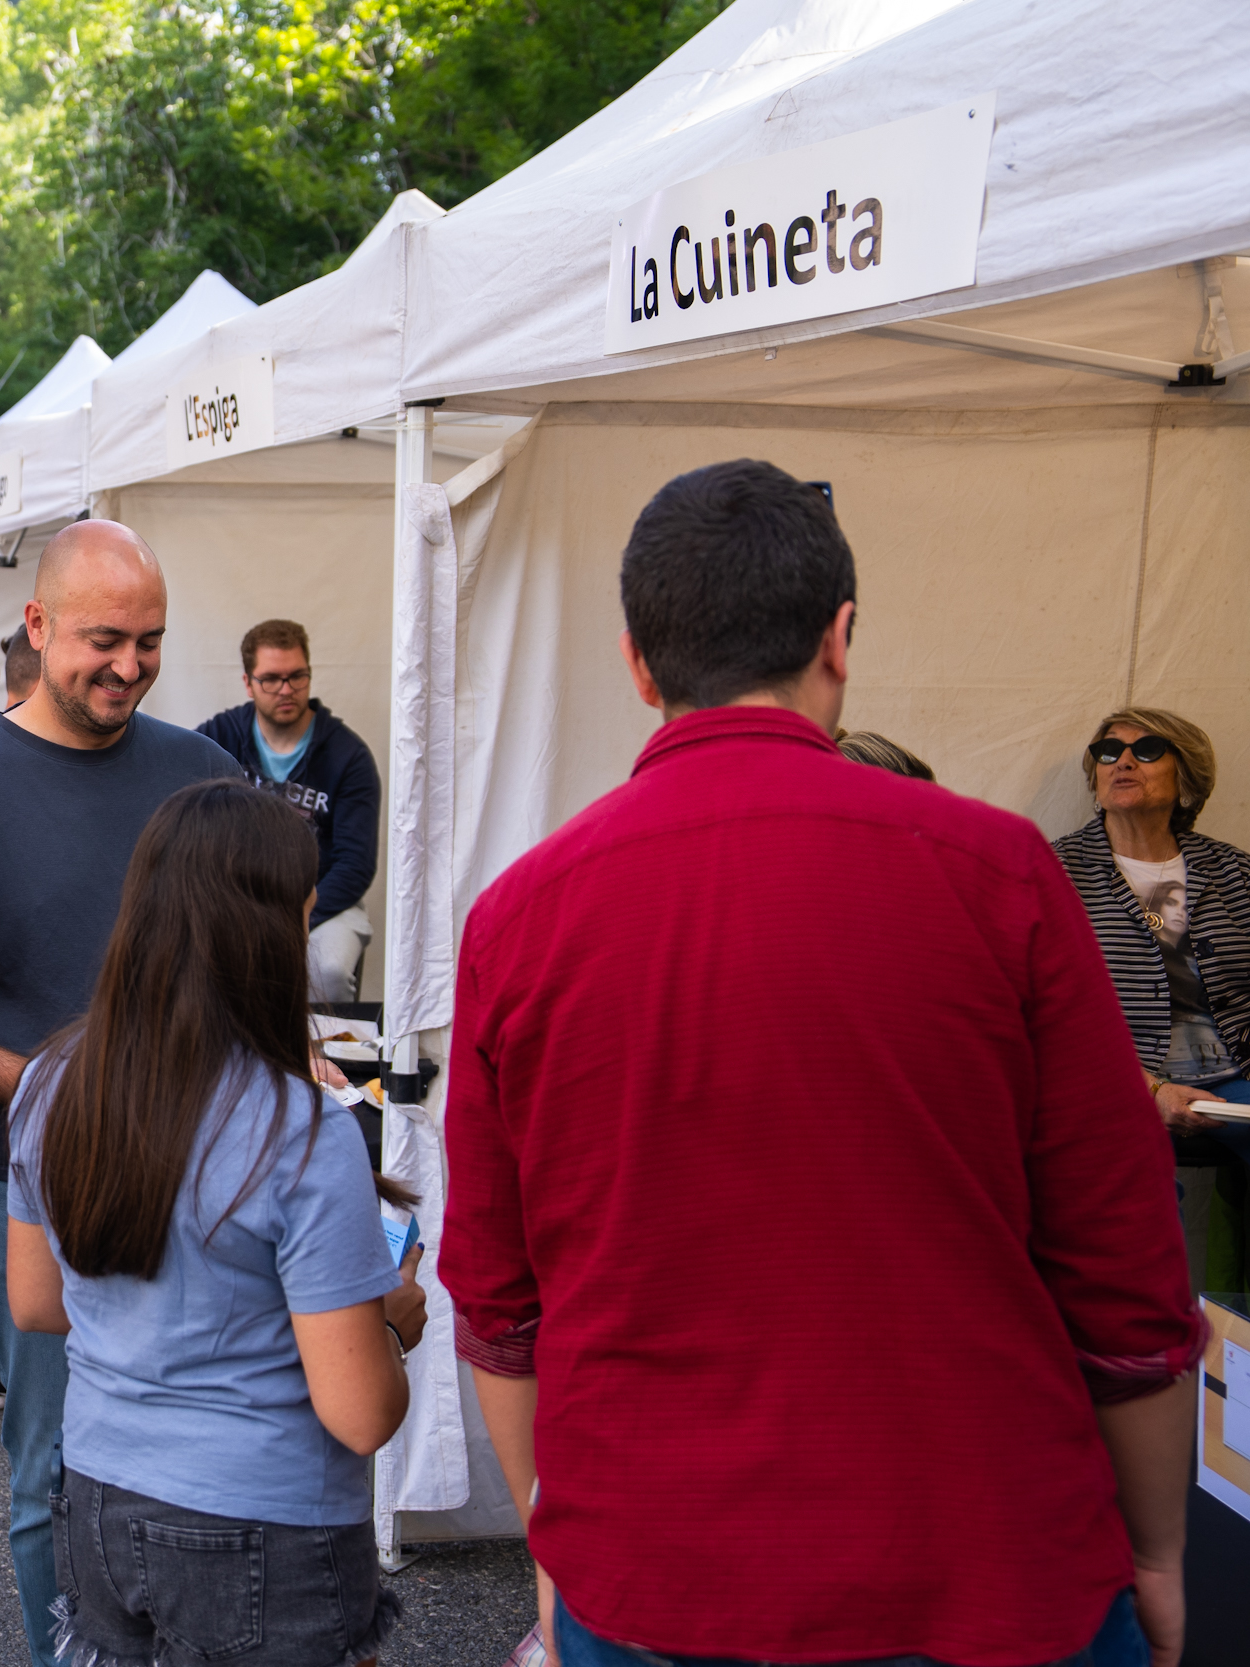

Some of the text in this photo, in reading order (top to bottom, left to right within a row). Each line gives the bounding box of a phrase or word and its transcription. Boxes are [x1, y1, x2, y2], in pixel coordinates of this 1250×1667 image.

[630, 189, 883, 323] La Cuineta
[185, 385, 239, 446] L'Espiga
